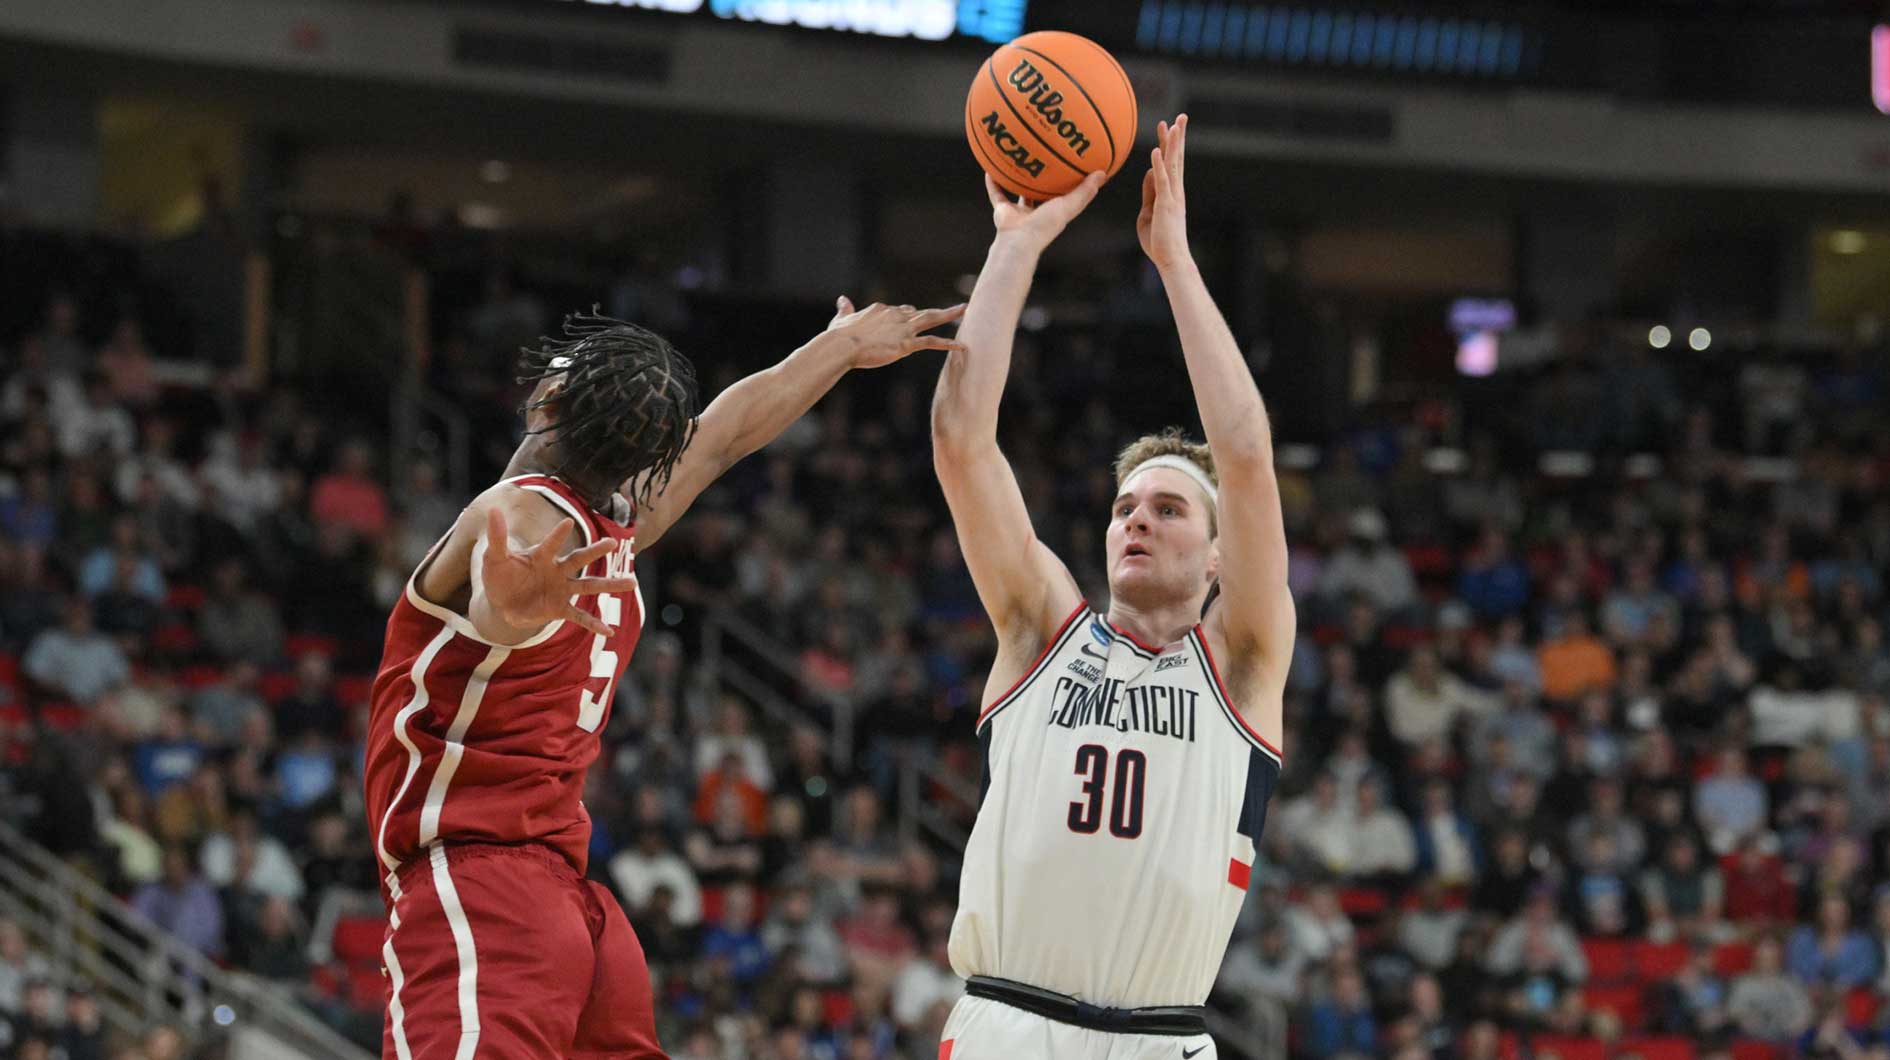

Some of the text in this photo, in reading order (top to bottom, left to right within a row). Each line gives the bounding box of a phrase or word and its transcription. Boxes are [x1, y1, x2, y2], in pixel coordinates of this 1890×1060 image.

[1008, 59, 1090, 157] Wilson
[982, 111, 1045, 178] NCAA
[577, 592, 622, 733] 5
[1067, 663, 1100, 683] CHANGE
[1086, 664, 1102, 676] THE
[1156, 657, 1189, 670] EAST
[1159, 653, 1181, 663] BIG
[1067, 744, 1147, 839] 30
